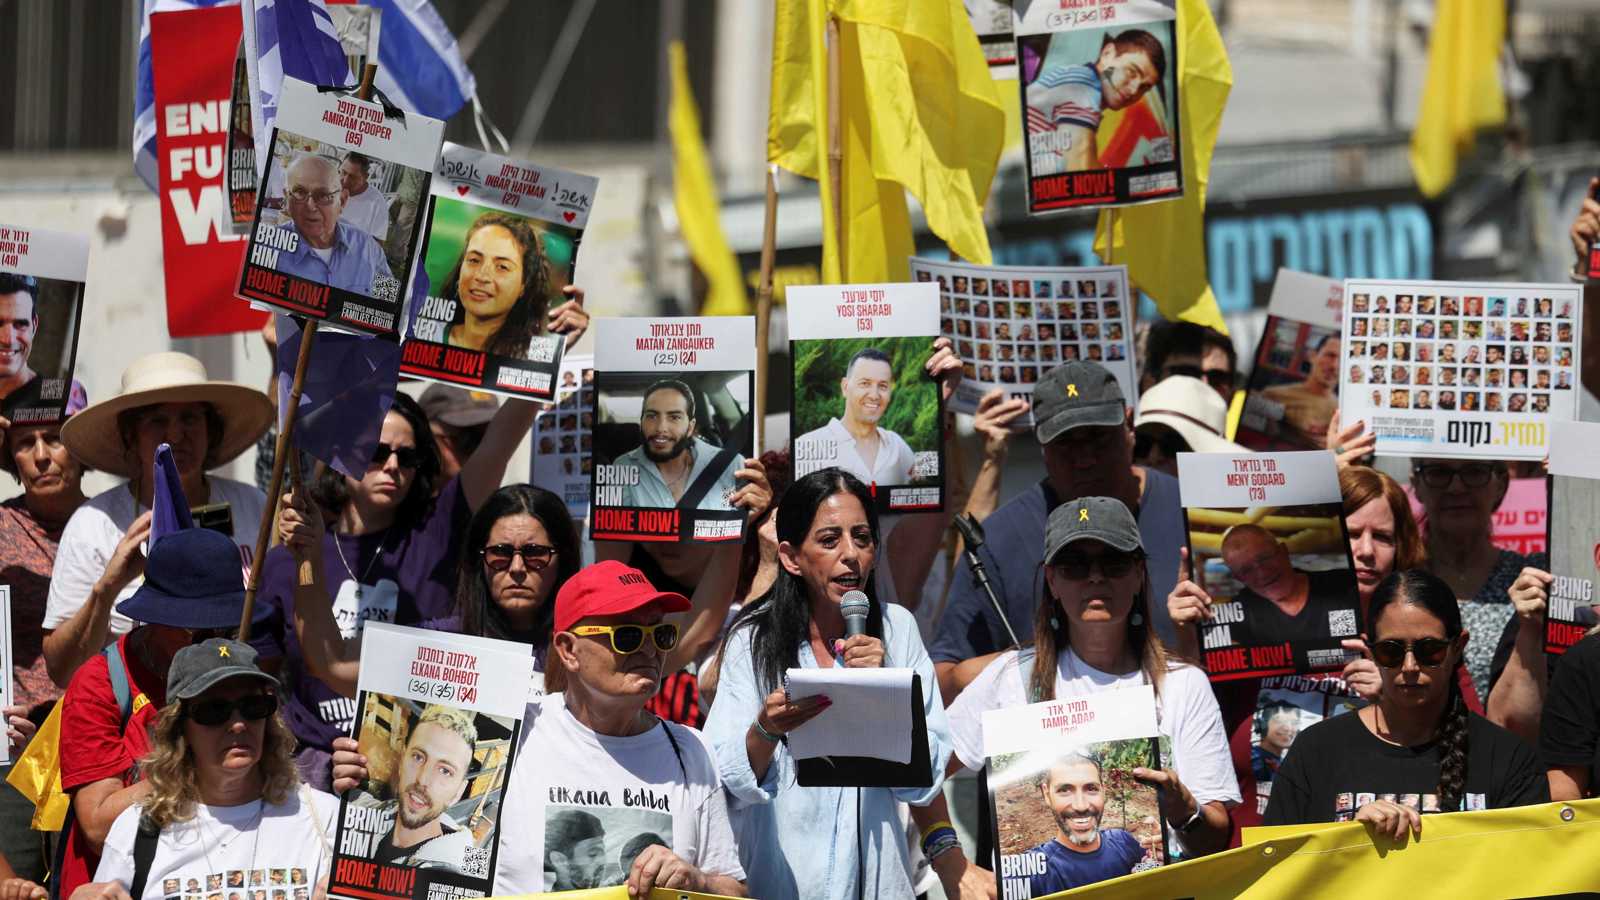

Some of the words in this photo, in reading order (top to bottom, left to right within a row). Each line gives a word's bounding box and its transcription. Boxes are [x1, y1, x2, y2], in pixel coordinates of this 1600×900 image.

[357, 105, 384, 124] עמירם
[322, 110, 358, 130] AMIRAM
[359, 120, 392, 141] COOPER
[345, 130, 363, 147] (85)
[521, 168, 541, 184] ענבר
[1033, 175, 1071, 200] HOME
[1074, 170, 1115, 196] NOW!
[484, 174, 511, 191] INBAR
[511, 180, 547, 200] HAYMAN
[0, 241, 16, 254] ROR
[18, 244, 29, 255] OR
[255, 222, 299, 253] BRING
[2, 254, 19, 268] (48)
[250, 243, 280, 270] HIM
[245, 266, 285, 297] HOME
[287, 275, 330, 309] NOW!
[842, 291, 868, 304] שרעבי
[870, 291, 885, 303] יוסי
[836, 306, 855, 317] YOSI
[856, 304, 891, 317] SHARABI
[686, 323, 701, 336] מתן
[857, 318, 873, 332] (53)
[636, 339, 665, 351] MATAN
[666, 338, 715, 350] ZANGAUKER
[402, 341, 444, 368] HOME
[444, 349, 486, 377] NOW!
[654, 353, 678, 366] (25)
[1493, 421, 1545, 448] נחזיר.
[796, 440, 840, 461] BRING
[596, 464, 639, 486] BRING
[1263, 459, 1276, 473] מני
[1227, 474, 1250, 487] MENY
[1251, 472, 1285, 486] GODARD
[595, 486, 624, 507] HIM
[1248, 487, 1265, 501] (73)
[595, 509, 635, 531] HOME
[637, 510, 680, 534] NOW!
[1548, 597, 1576, 622] HIM
[1203, 624, 1231, 649] HIM
[417, 646, 445, 664] בוחבוט
[446, 652, 478, 670] אלקנה
[1205, 649, 1248, 672] HOME
[1250, 641, 1294, 667] NOW!
[410, 661, 441, 681] ELKANA
[441, 668, 480, 687] BOHBOT
[408, 679, 430, 696] (36)
[1047, 705, 1064, 717] אדר
[1066, 700, 1089, 715] תמיר
[1042, 715, 1069, 730] TAMIR
[1070, 711, 1096, 725] ADAR
[549, 786, 612, 807] Elkana
[622, 788, 670, 812] Bohbot
[344, 803, 395, 836] BRING
[340, 829, 371, 858] HIM
[1001, 852, 1047, 878] BRING
[335, 858, 379, 887] HOME
[379, 866, 416, 897] NOW!
[1003, 877, 1032, 900] HIM
